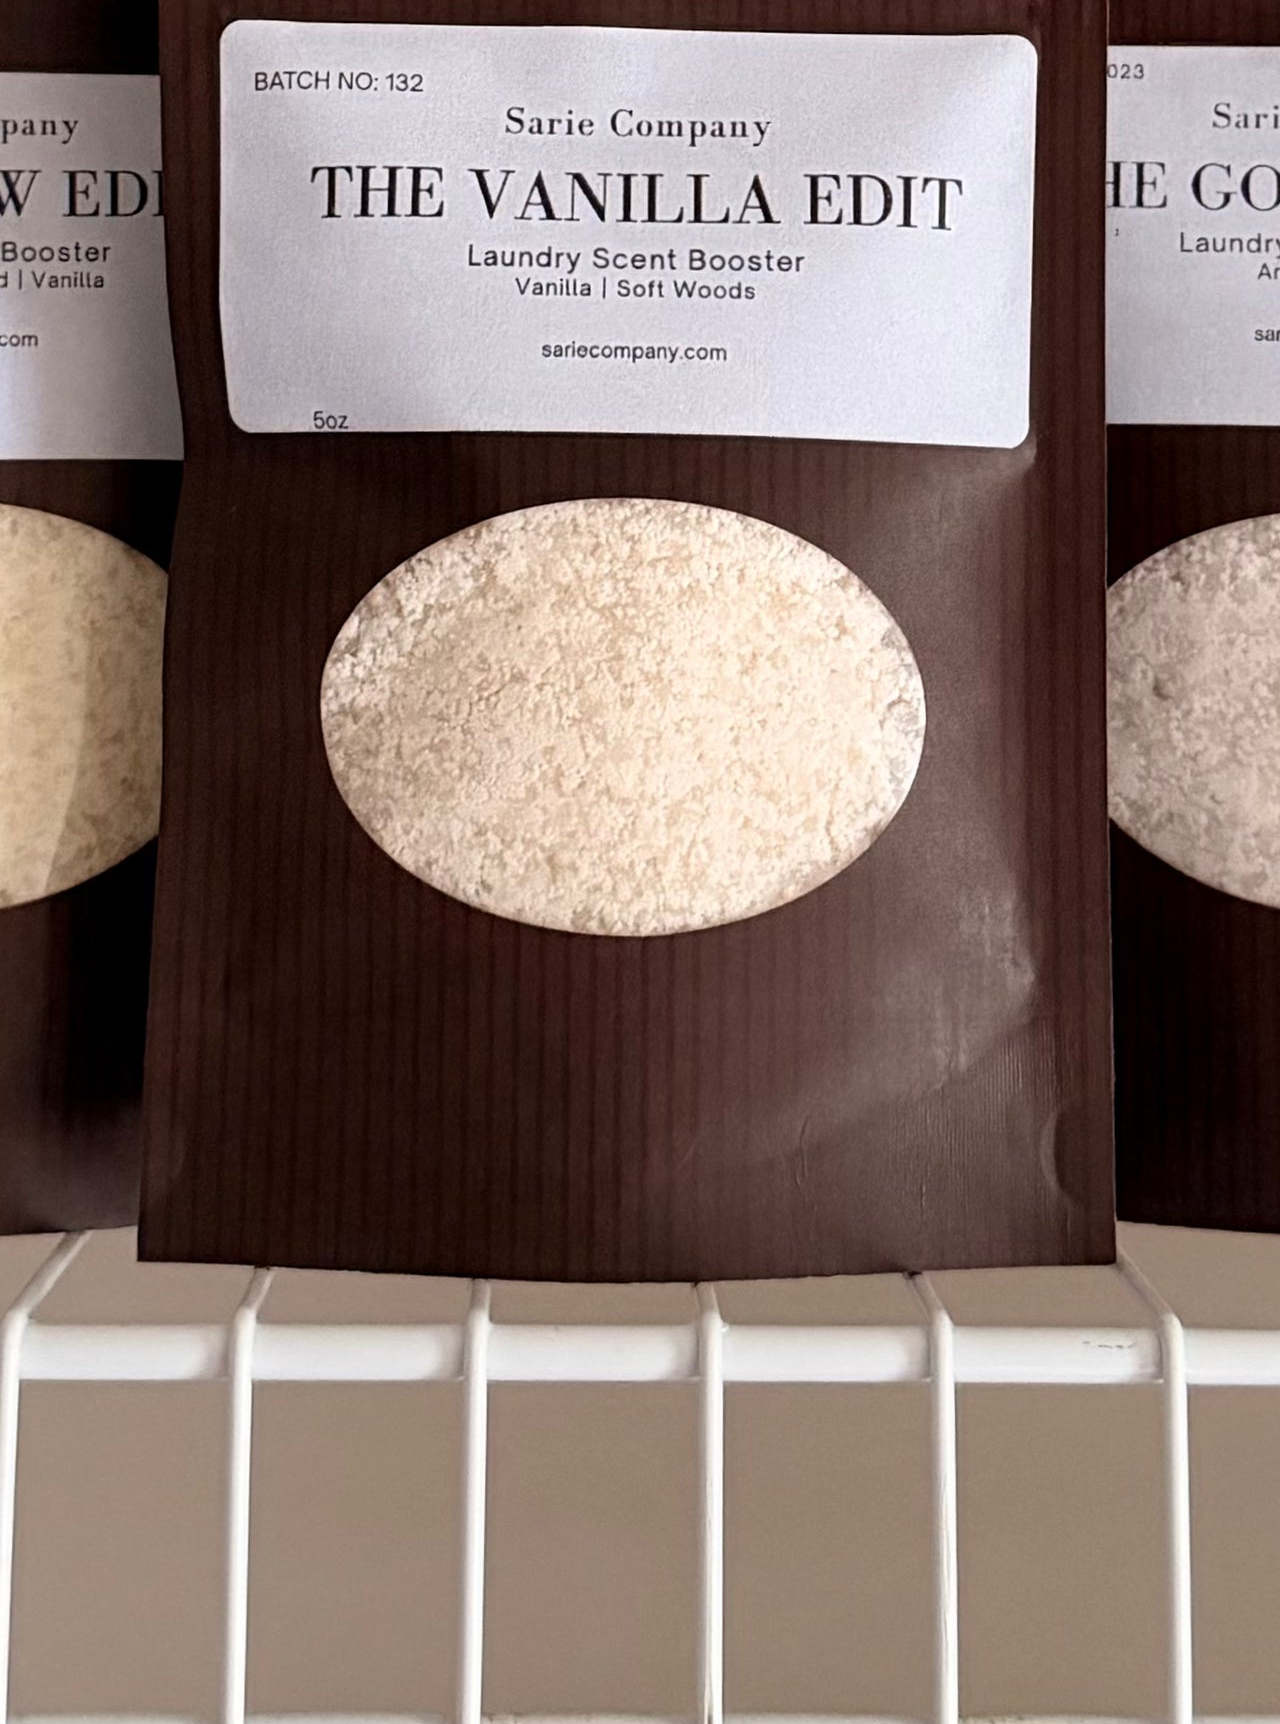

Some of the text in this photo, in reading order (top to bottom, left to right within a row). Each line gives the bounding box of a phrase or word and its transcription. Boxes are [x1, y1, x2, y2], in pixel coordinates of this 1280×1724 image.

[255, 70, 423, 92] BATCH NO: 132
[505, 107, 771, 147] Sarie Company
[310, 165, 963, 231] THE VANILLA EDIT
[0, 241, 111, 263] Booster
[468, 244, 805, 275] Laundry Scent Booster
[31, 270, 104, 289] Vanilla
[515, 277, 591, 297] Vanilla
[617, 279, 664, 298] Soft
[673, 280, 755, 300] Woods
[542, 341, 727, 364] sariecompany.com
[313, 411, 349, 430] 5oz
